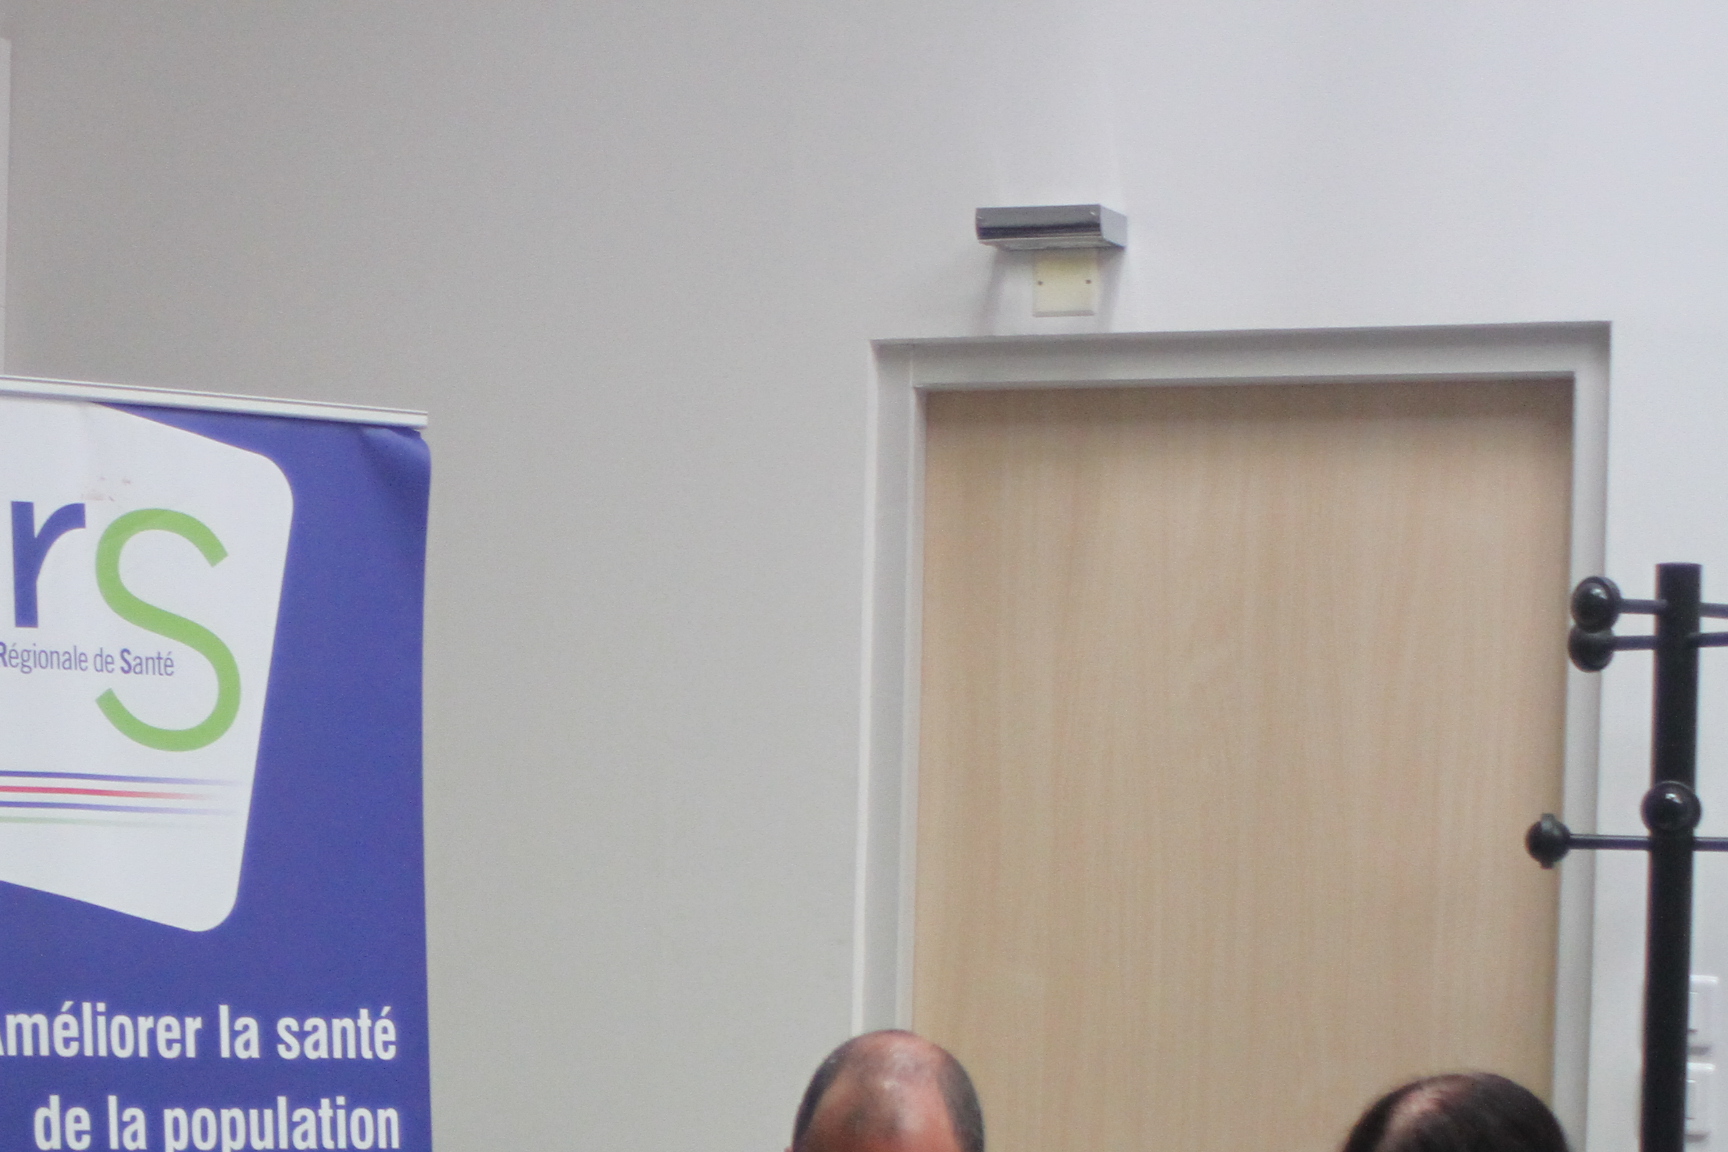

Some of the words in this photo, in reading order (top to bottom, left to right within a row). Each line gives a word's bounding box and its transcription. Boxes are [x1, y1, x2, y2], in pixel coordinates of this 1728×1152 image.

[93, 648, 115, 673] de
[120, 648, 175, 676] Santé
[219, 1005, 260, 1059] la
[277, 1007, 397, 1061] santé
[34, 1095, 91, 1150] de
[108, 1095, 146, 1150] la
